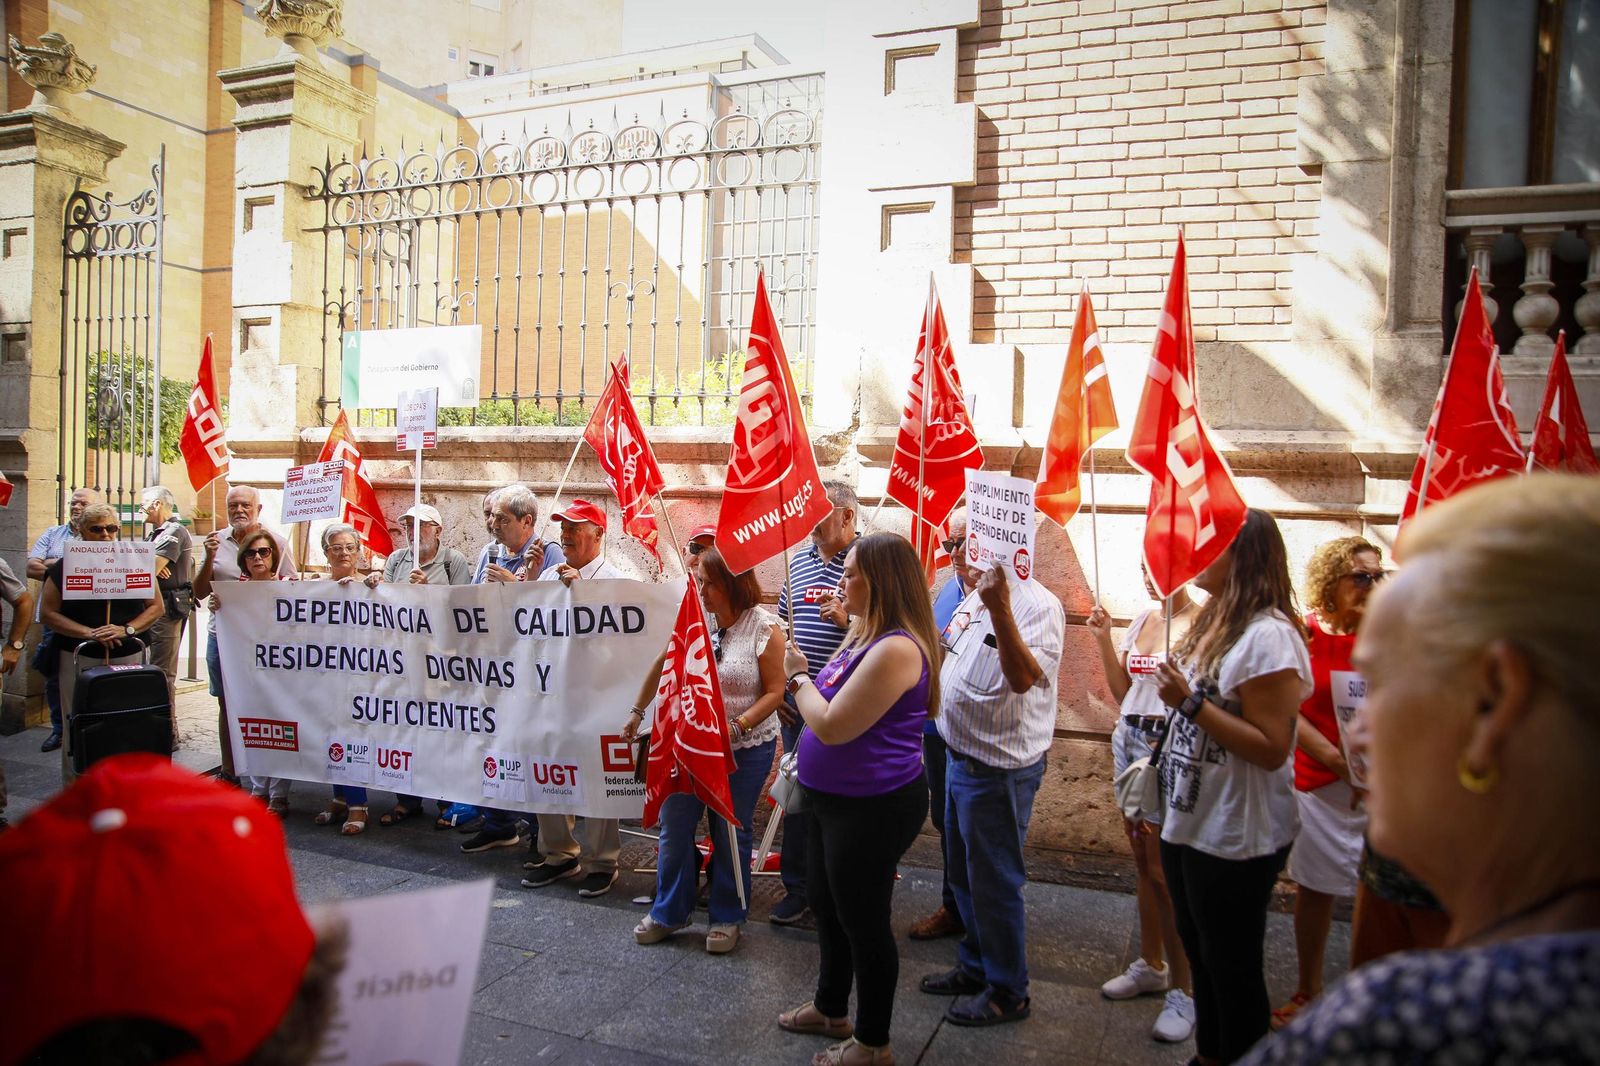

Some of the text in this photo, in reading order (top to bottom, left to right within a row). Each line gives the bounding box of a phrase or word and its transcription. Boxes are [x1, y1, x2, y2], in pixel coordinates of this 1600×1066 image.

[410, 364, 438, 372] Gobierno
[310, 474, 340, 484] PERSONAS
[303, 485, 334, 496] FALLECIDO
[968, 481, 1030, 506] CUMPLIMIENTO
[294, 496, 328, 506] ESPERANDO
[972, 500, 1026, 526] DE LA LEY DE
[971, 519, 1028, 547] DEPENDENCIA
[276, 598, 646, 637] DEPENDENCIA DE CALIDAD
[256, 644, 552, 692] RESIDENCIAS DIGNAS Y
[1130, 656, 1158, 668] CCOO
[352, 695, 496, 734] SUFICIENTES
[353, 744, 368, 756] UJP
[376, 748, 412, 772] UGT
[505, 760, 522, 772] UJP
[382, 770, 405, 780] Andalucía
[533, 763, 578, 787] UGT
[542, 787, 573, 796] Andalucía
